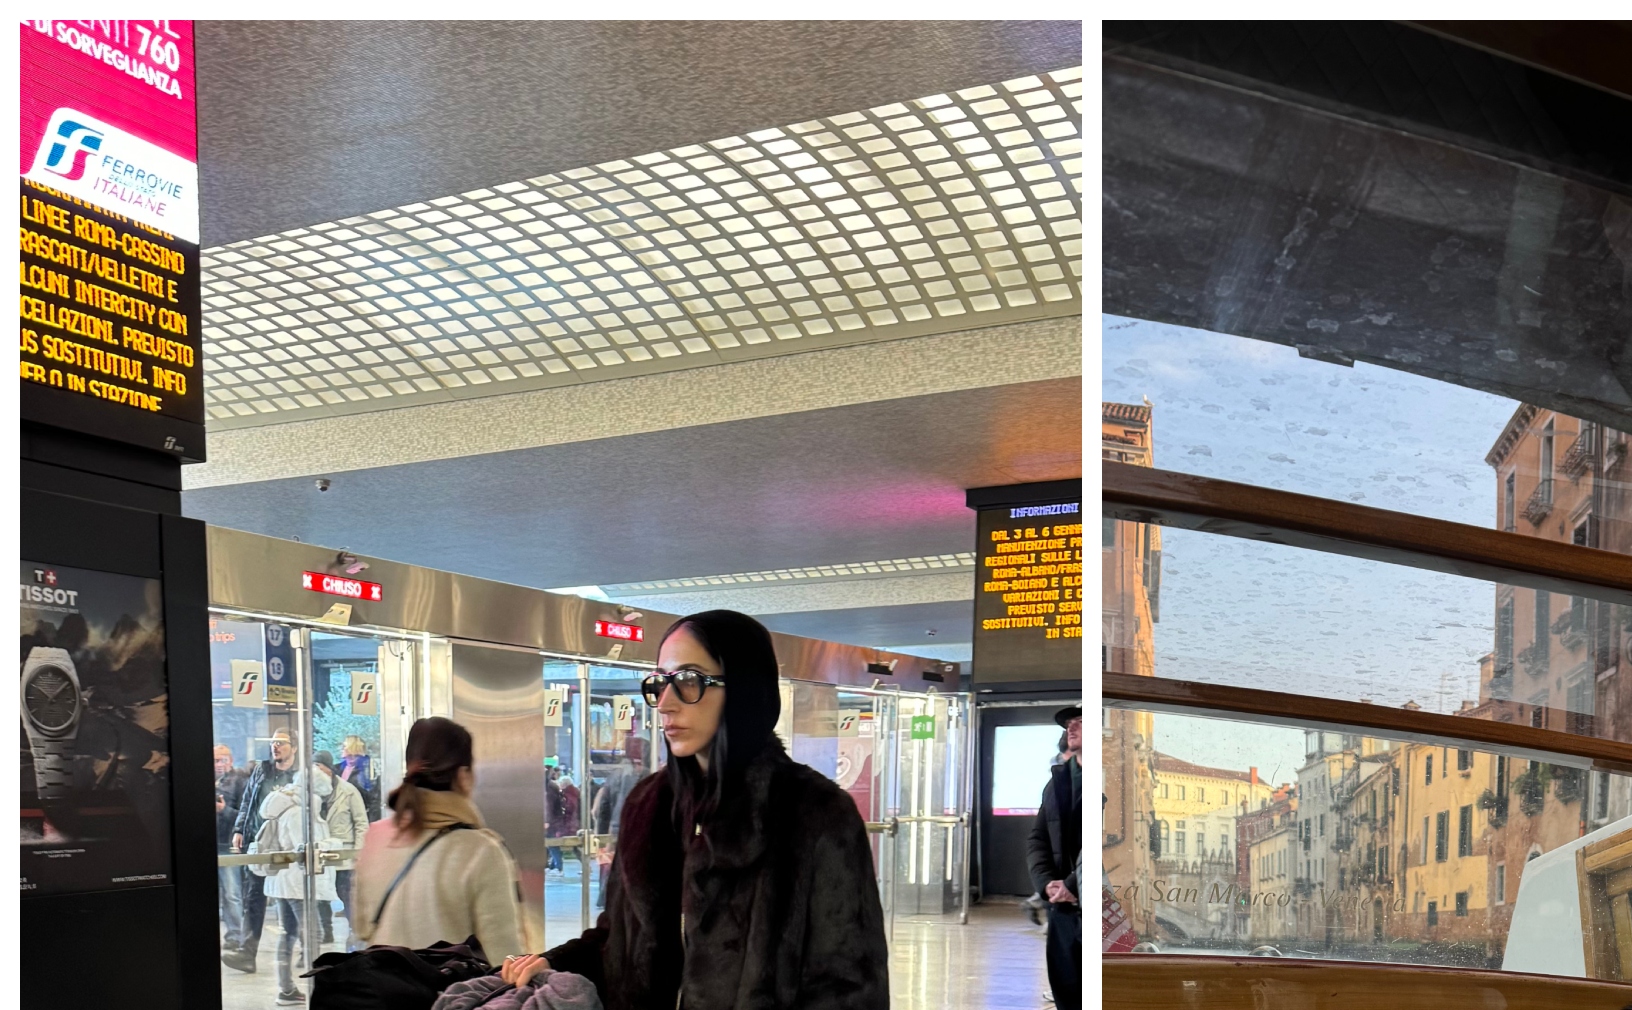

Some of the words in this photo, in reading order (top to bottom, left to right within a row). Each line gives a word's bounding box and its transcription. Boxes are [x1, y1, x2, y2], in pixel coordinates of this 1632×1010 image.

[136, 24, 180, 72] 760
[56, 22, 183, 100] SORVEGLIANZA
[102, 155, 183, 199] FERROVIE
[94, 177, 167, 217] ITALIANE
[22, 195, 71, 234] LINEE
[74, 214, 185, 274] ROMA-CASSINO
[167, 279, 179, 303] E
[75, 279, 156, 325] INTERCITY
[158, 307, 188, 336] CON
[123, 326, 194, 367] PREVISTO
[42, 335, 148, 384] SOSTITUTIVI.
[152, 366, 187, 395] INFO
[1010, 503, 1079, 518] INFORMAZIONI
[991, 530, 1011, 541] DAL
[1013, 528, 1022, 539] 3
[1025, 527, 1038, 539] AL
[1041, 526, 1050, 537] 6
[996, 537, 1066, 554] MANUTENZIONE
[985, 553, 1036, 567] REGIONALI
[1041, 551, 1071, 563] SULLE
[34, 569, 44, 582] T
[1051, 576, 1059, 588] E
[322, 577, 362, 596] CHIUSO
[1002, 589, 1060, 603] VARIAZIONI
[1064, 588, 1072, 600] E
[1007, 602, 1055, 616] PREVISTO
[982, 616, 1049, 630] SOSTITUTIVI.
[1055, 613, 1080, 626] INFO
[215, 632, 236, 644] trips
[270, 628, 280, 641] 17
[607, 623, 632, 639] CHIUSO
[1046, 628, 1060, 639] IN
[1150, 879, 1198, 903] San
[1208, 882, 1291, 908] Marco
